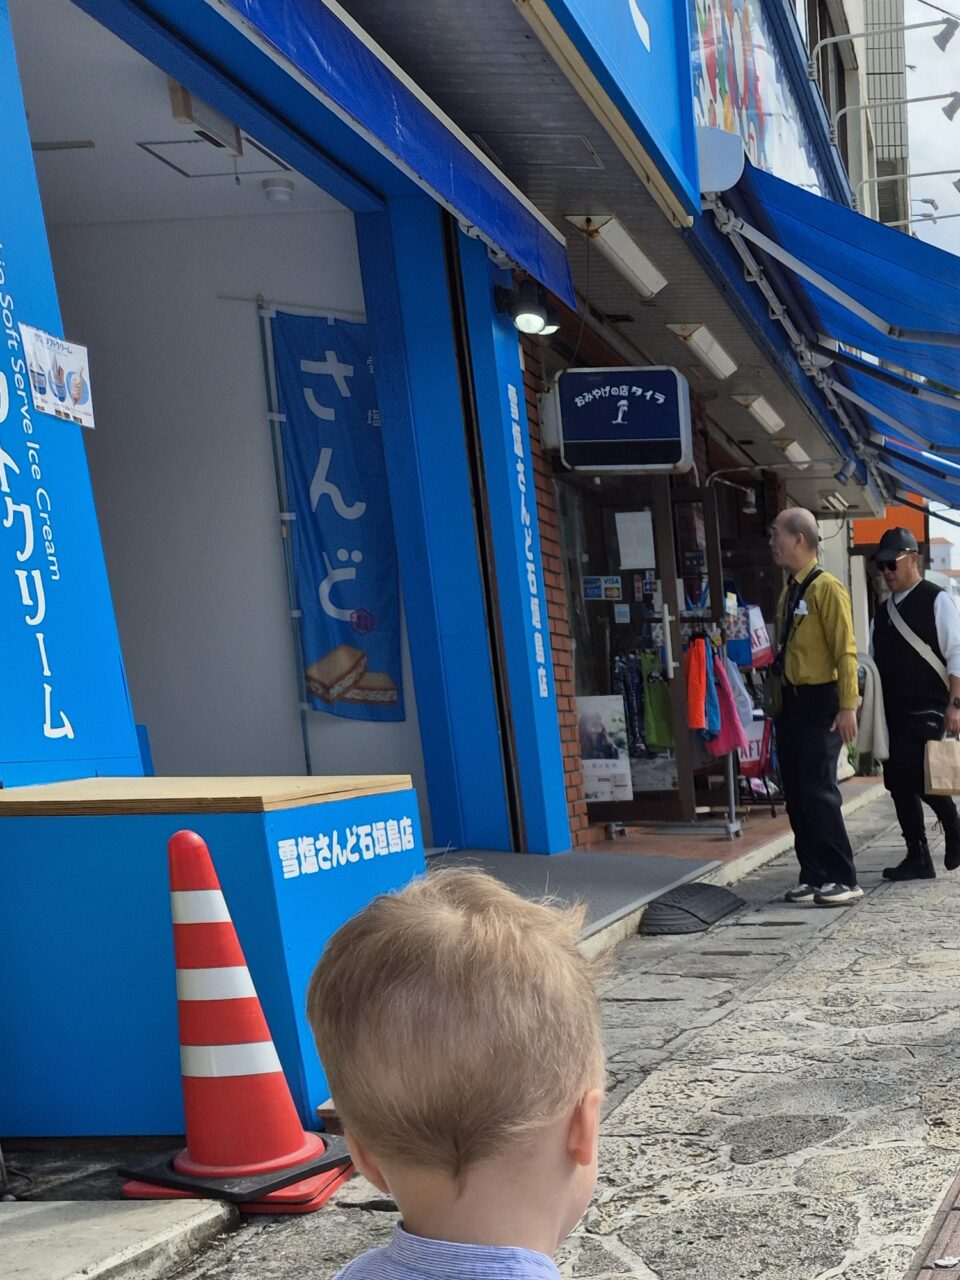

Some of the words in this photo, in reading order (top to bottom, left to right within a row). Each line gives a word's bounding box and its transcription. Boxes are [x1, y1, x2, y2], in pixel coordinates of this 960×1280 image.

[0, 292, 20, 350] Soft
[11, 357, 33, 435] Serve
[26, 440, 42, 480] Ice
[36, 487, 60, 580] Cream
[300, 351, 367, 622] さんど
[604, 577, 620, 585] VISA
[277, 816, 415, 880] 雪塩さんど石垣島店
